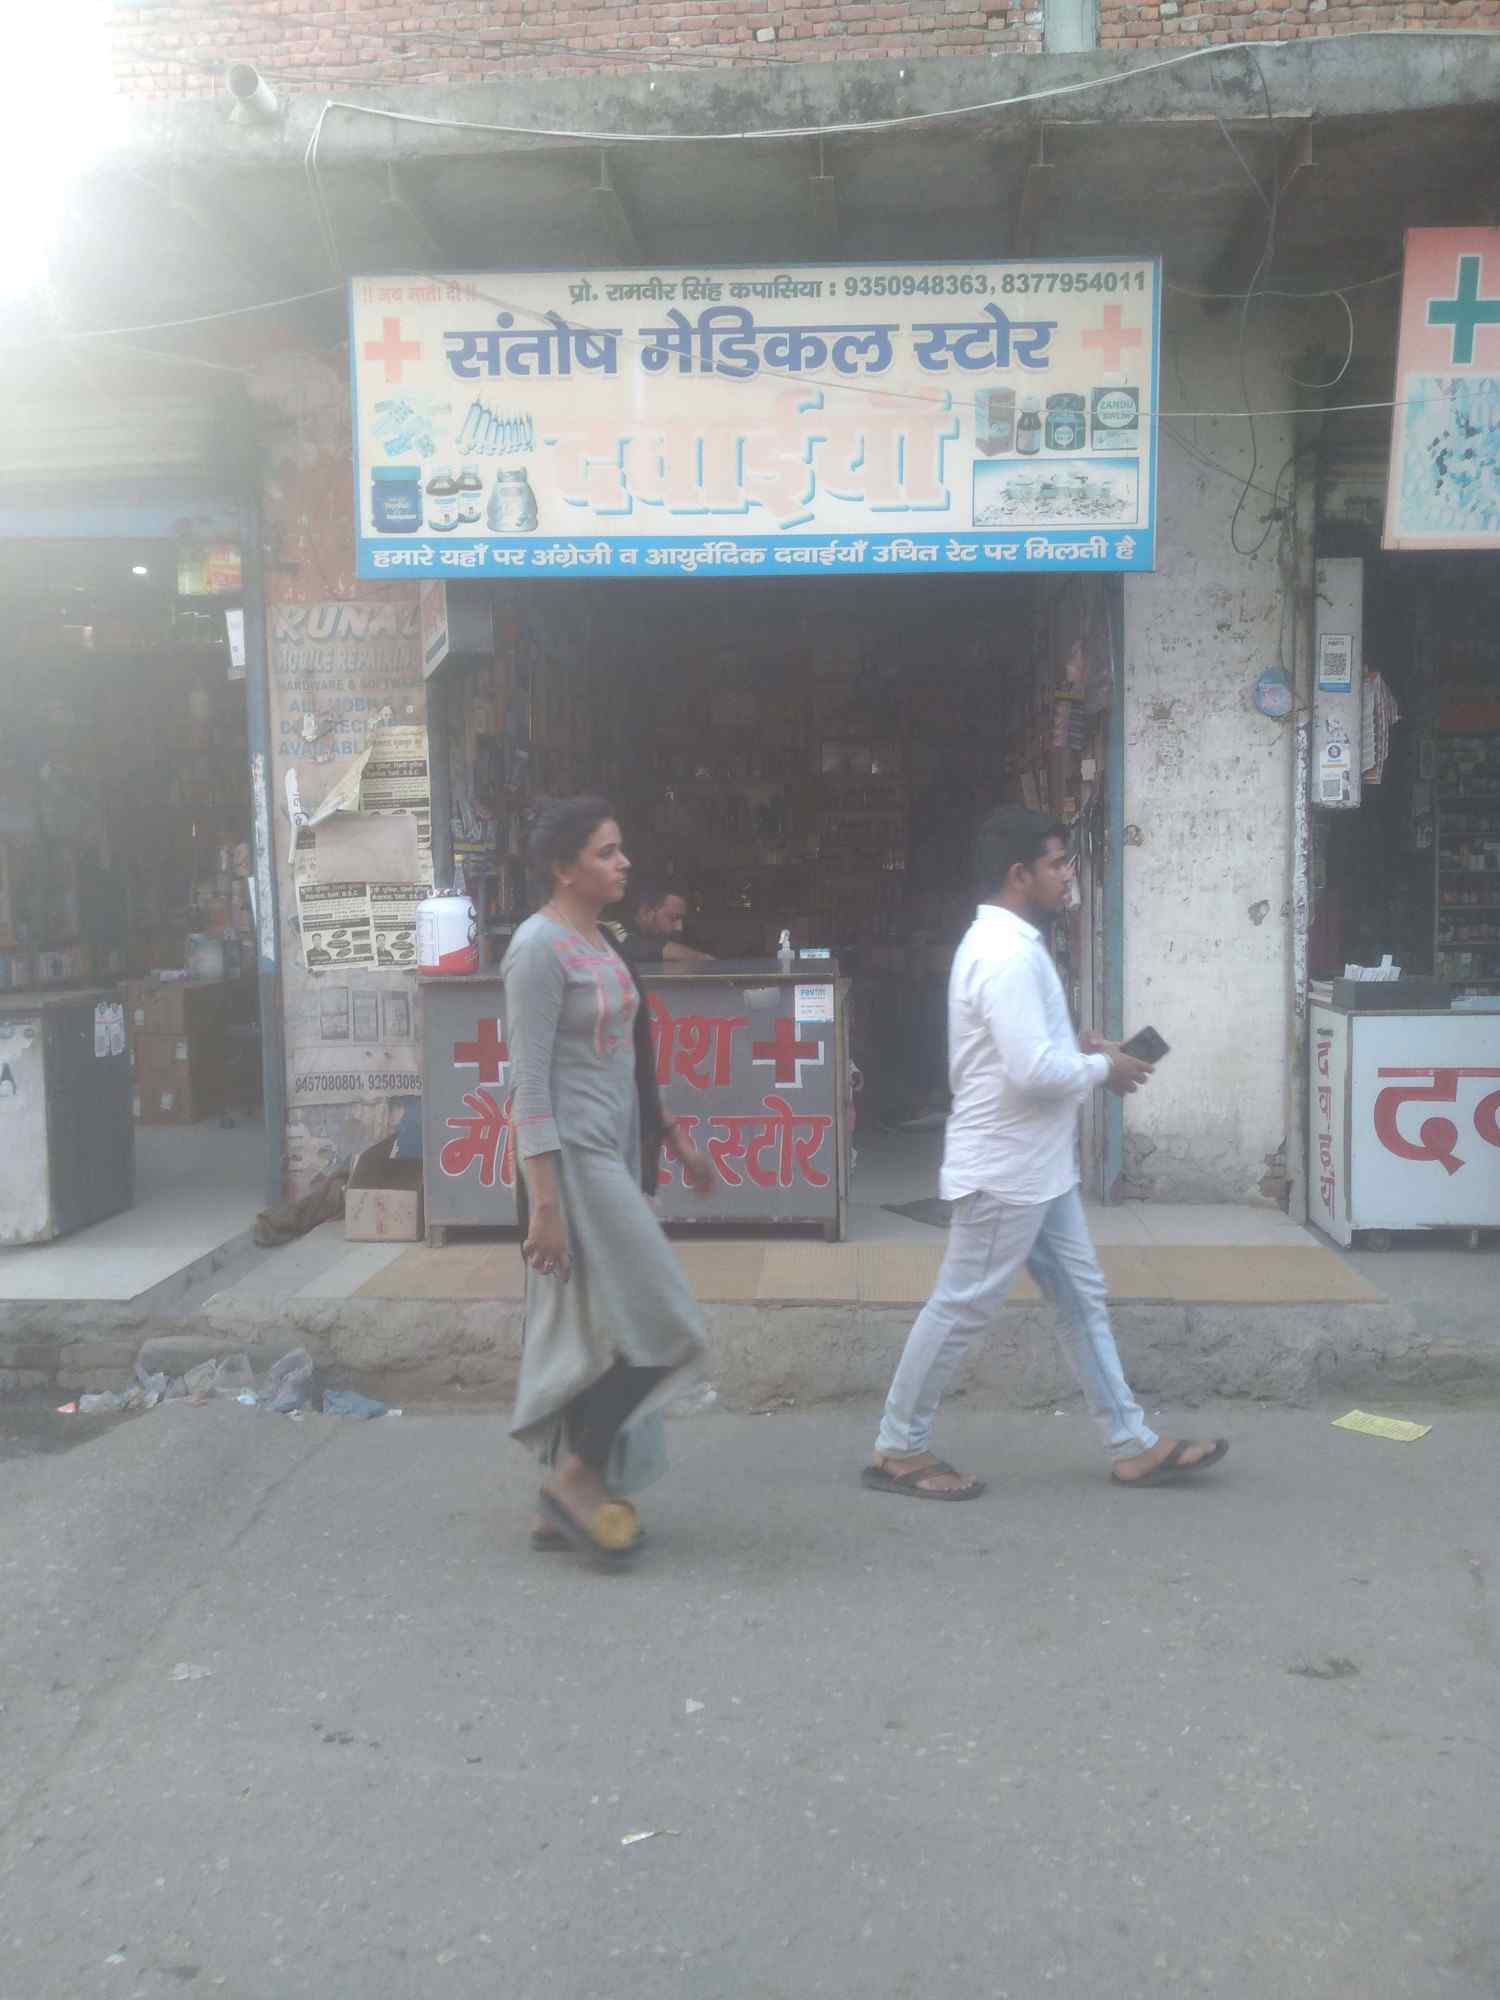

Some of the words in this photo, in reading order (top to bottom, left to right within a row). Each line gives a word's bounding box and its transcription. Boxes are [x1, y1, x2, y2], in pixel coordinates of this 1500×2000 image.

[606, 279, 675, 301] रामवीर
[682, 275, 722, 301] सिंह
[730, 275, 822, 300] कपासिया
[1001, 270, 1145, 296] 8377954011
[443, 309, 623, 379] संतोष
[638, 304, 900, 382] मेडिकल
[911, 301, 1058, 372] स्टोर
[372, 544, 434, 568] हमारे
[493, 548, 525, 567] पर
[531, 543, 612, 571] अंग्रेजी
[619, 548, 638, 566] व
[873, 540, 937, 565] उचित
[946, 538, 978, 564] रेट
[984, 543, 1017, 562] पर
[1026, 537, 1109, 562] मिलती
[707, 1094, 832, 1188] स्टोर
